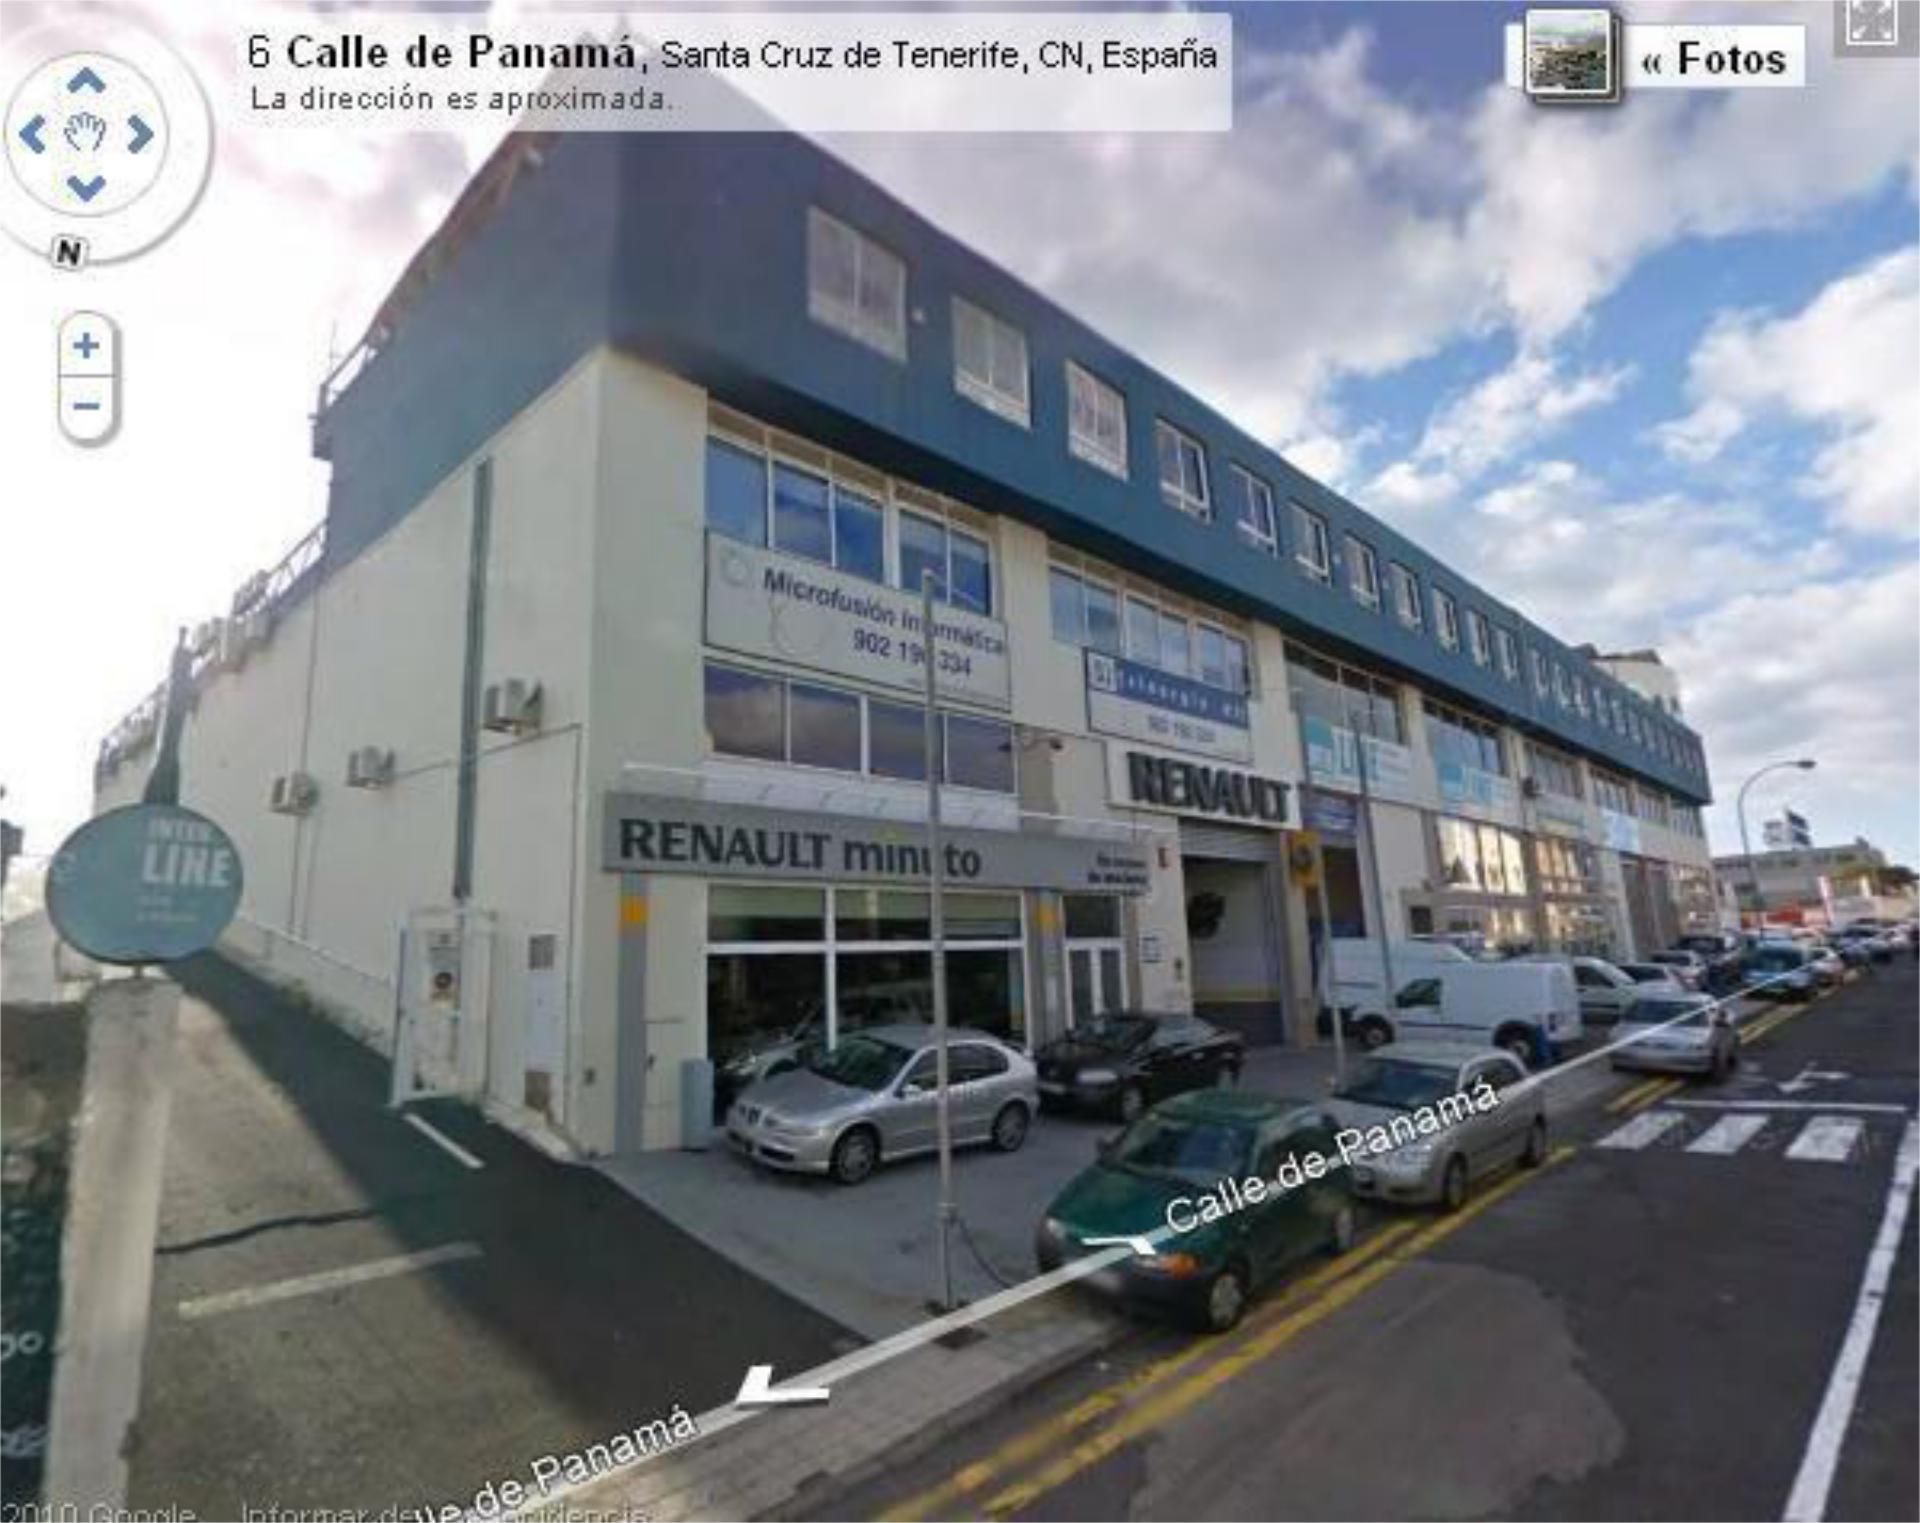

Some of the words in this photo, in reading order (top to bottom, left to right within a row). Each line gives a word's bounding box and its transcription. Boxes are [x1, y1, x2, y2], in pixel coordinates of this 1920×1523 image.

[763, 566, 896, 625] Microfusión
[853, 629, 891, 657] 902
[1126, 751, 1292, 823] RENAULT
[618, 817, 831, 872] RENAULT
